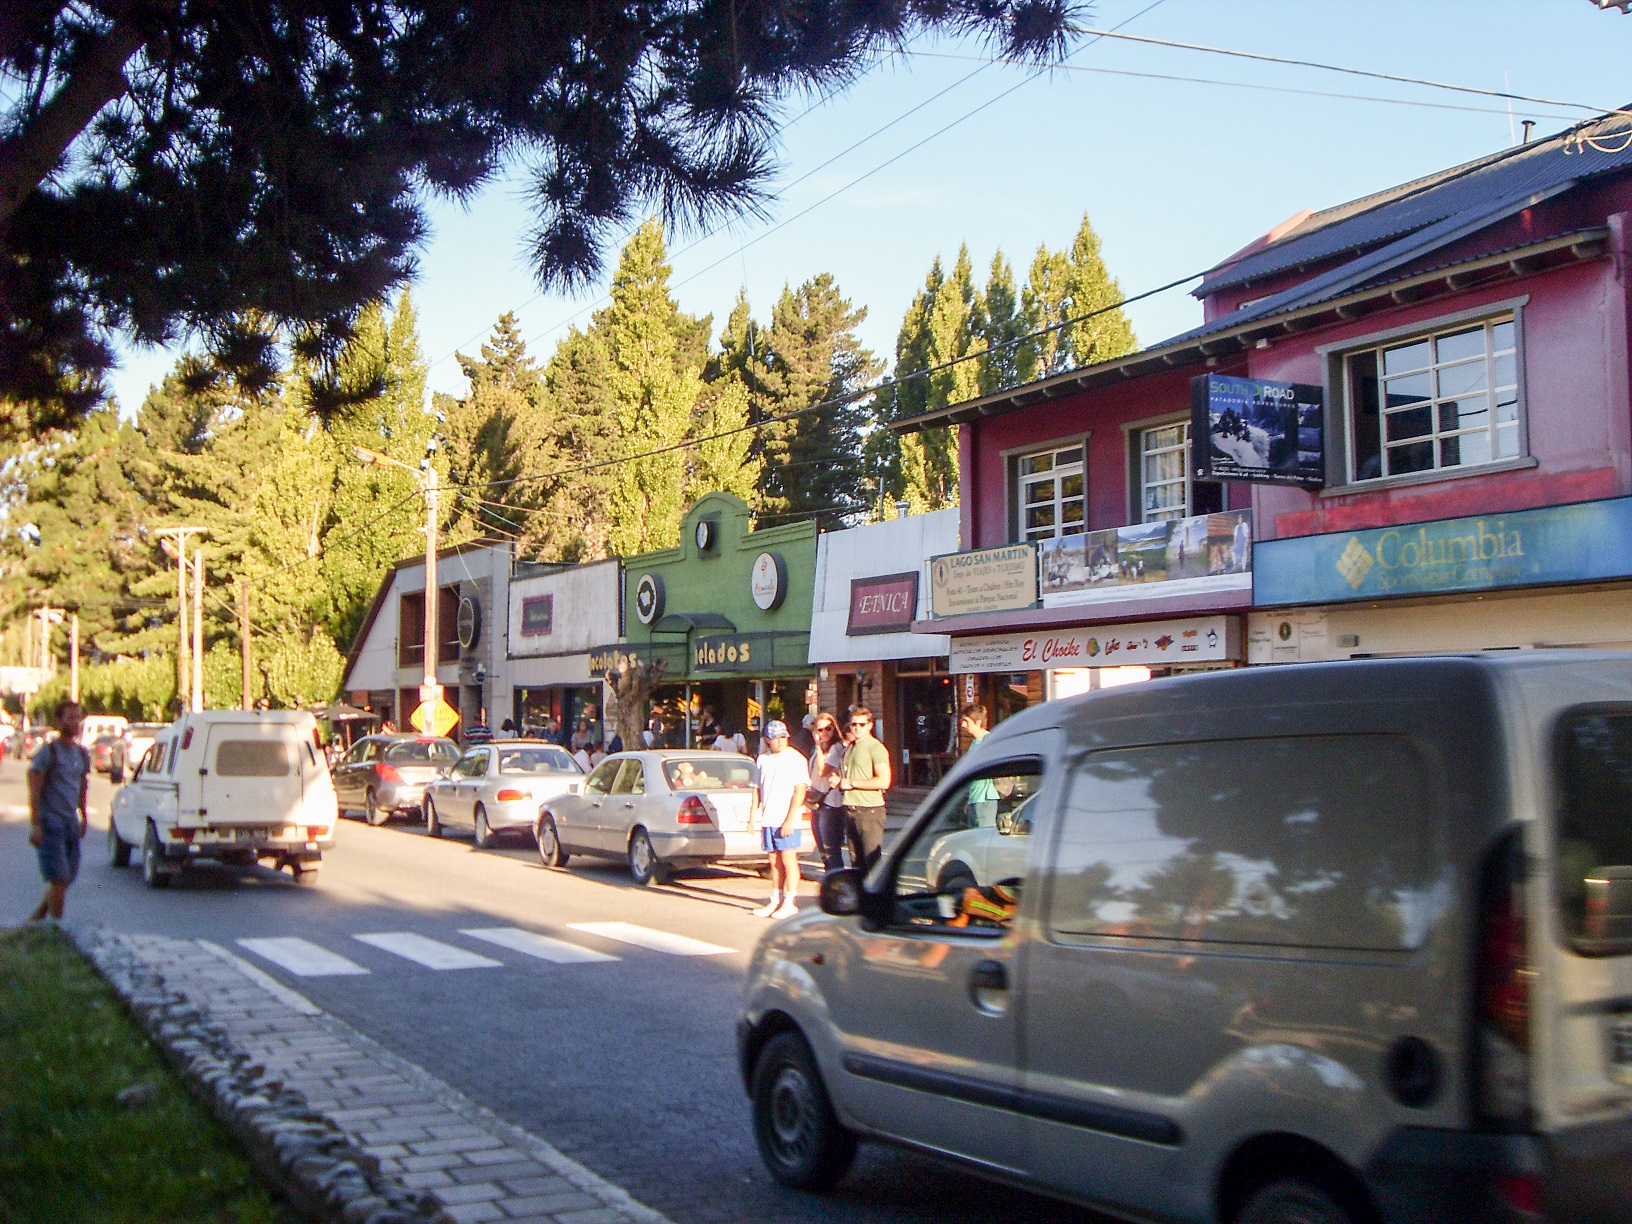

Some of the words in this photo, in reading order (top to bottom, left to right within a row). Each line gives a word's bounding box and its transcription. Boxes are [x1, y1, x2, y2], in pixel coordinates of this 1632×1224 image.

[1210, 381, 1249, 395] SOUTH
[1263, 385, 1295, 400] ROAD
[1376, 520, 1525, 570] Columbia
[951, 555, 973, 568] LAGO
[974, 553, 992, 565] SAN
[993, 547, 1029, 562] MARTIN
[997, 561, 1025, 573] TURISMO
[860, 591, 909, 614] ETNICA
[695, 641, 750, 665] elados
[1022, 638, 1038, 661] El
[1041, 637, 1080, 662] Choike
